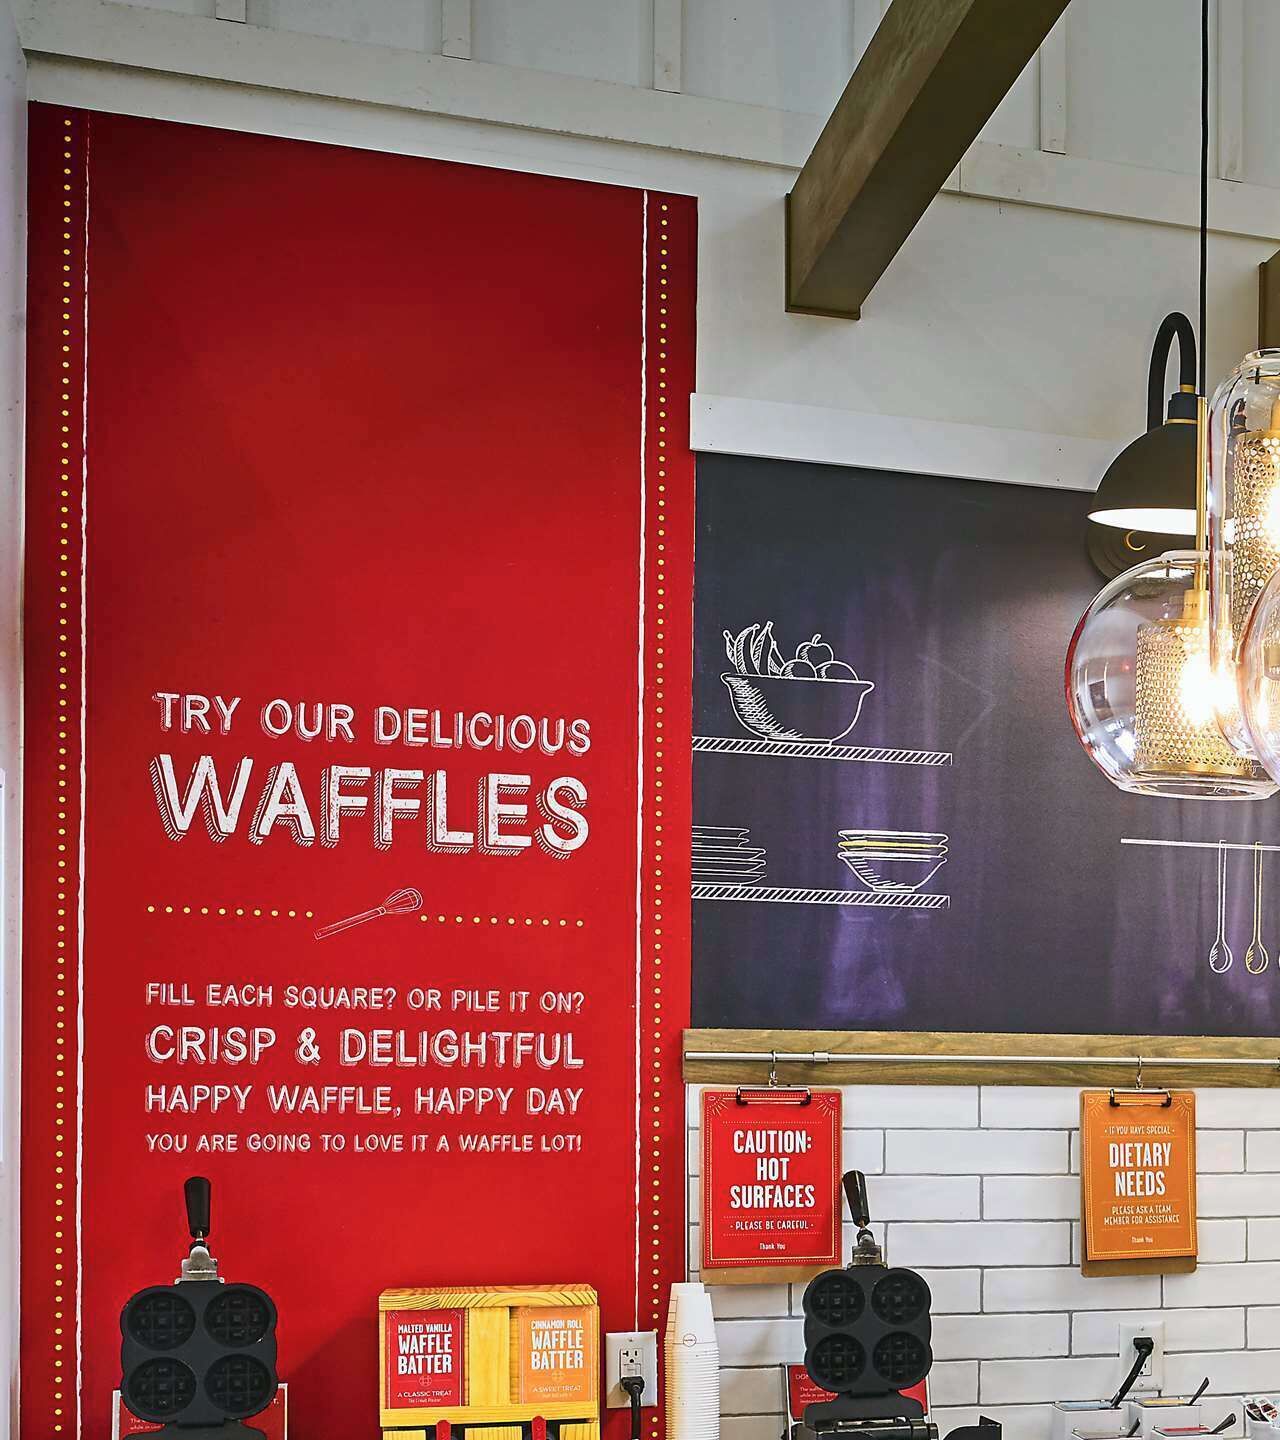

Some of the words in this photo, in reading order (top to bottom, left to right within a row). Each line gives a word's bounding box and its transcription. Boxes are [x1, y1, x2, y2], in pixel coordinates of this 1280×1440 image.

[155, 692, 241, 735] TRY
[260, 699, 355, 743] OUR
[375, 707, 592, 757] DELICIOUS
[149, 753, 589, 860] WAFFLES
[146, 984, 195, 1006] FILL
[206, 984, 273, 1009] EACH
[283, 985, 397, 1011] SQUARE?
[406, 988, 441, 1011] OR
[452, 990, 499, 1012] PILE
[510, 991, 531, 1012] IT
[539, 991, 585, 1015] ON?
[145, 1026, 277, 1066] CRISP
[296, 1027, 322, 1065] &
[340, 1029, 584, 1069] DELIGHTFUL
[145, 1085, 252, 1113] HAPPY
[268, 1086, 401, 1116] WAFFLE,
[414, 1088, 514, 1115] HAPPY
[526, 1088, 584, 1115] DAY
[1146, 1126, 1170, 1134] SPECIAL
[146, 1133, 186, 1153] YOU
[196, 1133, 237, 1153] ARE
[247, 1133, 310, 1153] GOING
[320, 1133, 346, 1153] TO
[353, 1134, 403, 1152] LOVE
[411, 1134, 427, 1152] IT
[436, 1134, 450, 1152] A
[458, 1134, 533, 1152] WAFFLE
[541, 1134, 582, 1152] LOT!
[734, 1130, 812, 1153] CAUTION:
[1109, 1142, 1171, 1168] DIETARY
[756, 1158, 789, 1181] HOT
[1115, 1171, 1166, 1197] NEEDS
[730, 1185, 815, 1209] SURFACES
[1104, 1216, 1130, 1225] MEMBER
[1131, 1216, 1143, 1225] FOR
[1144, 1215, 1180, 1223] ASSISTANCE
[1112, 1206, 1134, 1215] PLEASE
[1136, 1206, 1148, 1214] ASK
[1155, 1205, 1171, 1213] TEAM
[735, 1221, 763, 1230] PLEASE
[766, 1221, 774, 1229] BE
[777, 1221, 809, 1229] CAREFUL
[398, 1324, 423, 1333] MALTED
[426, 1323, 452, 1333] VANILLA
[531, 1320, 565, 1330] CINNAMON
[567, 1319, 583, 1329] ROLL
[398, 1334, 452, 1355] WAFFLE
[531, 1329, 584, 1350] WAFFLE
[398, 1354, 452, 1375] BATTER
[531, 1350, 584, 1370] BATTER
[403, 1390, 430, 1398] CLASSIC
